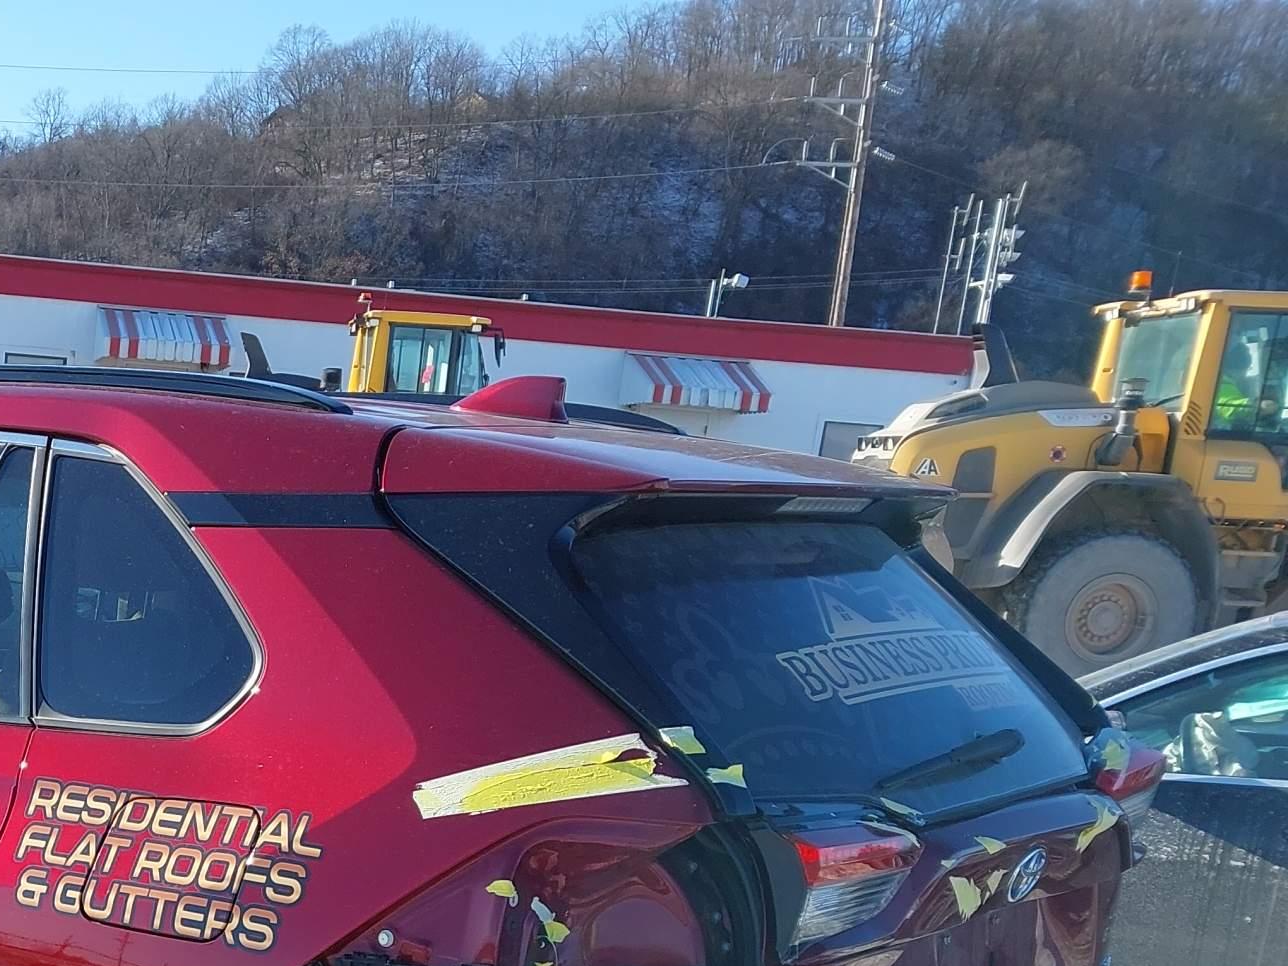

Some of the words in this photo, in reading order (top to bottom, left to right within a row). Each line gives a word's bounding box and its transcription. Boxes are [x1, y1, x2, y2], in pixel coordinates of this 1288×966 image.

[780, 634, 944, 697] BUSINESS
[26, 779, 323, 859] RESIDENTIAL
[16, 826, 133, 874] FLAT
[132, 842, 307, 904] ROOFS
[16, 869, 48, 908] &
[54, 873, 279, 952] GUTTERS
